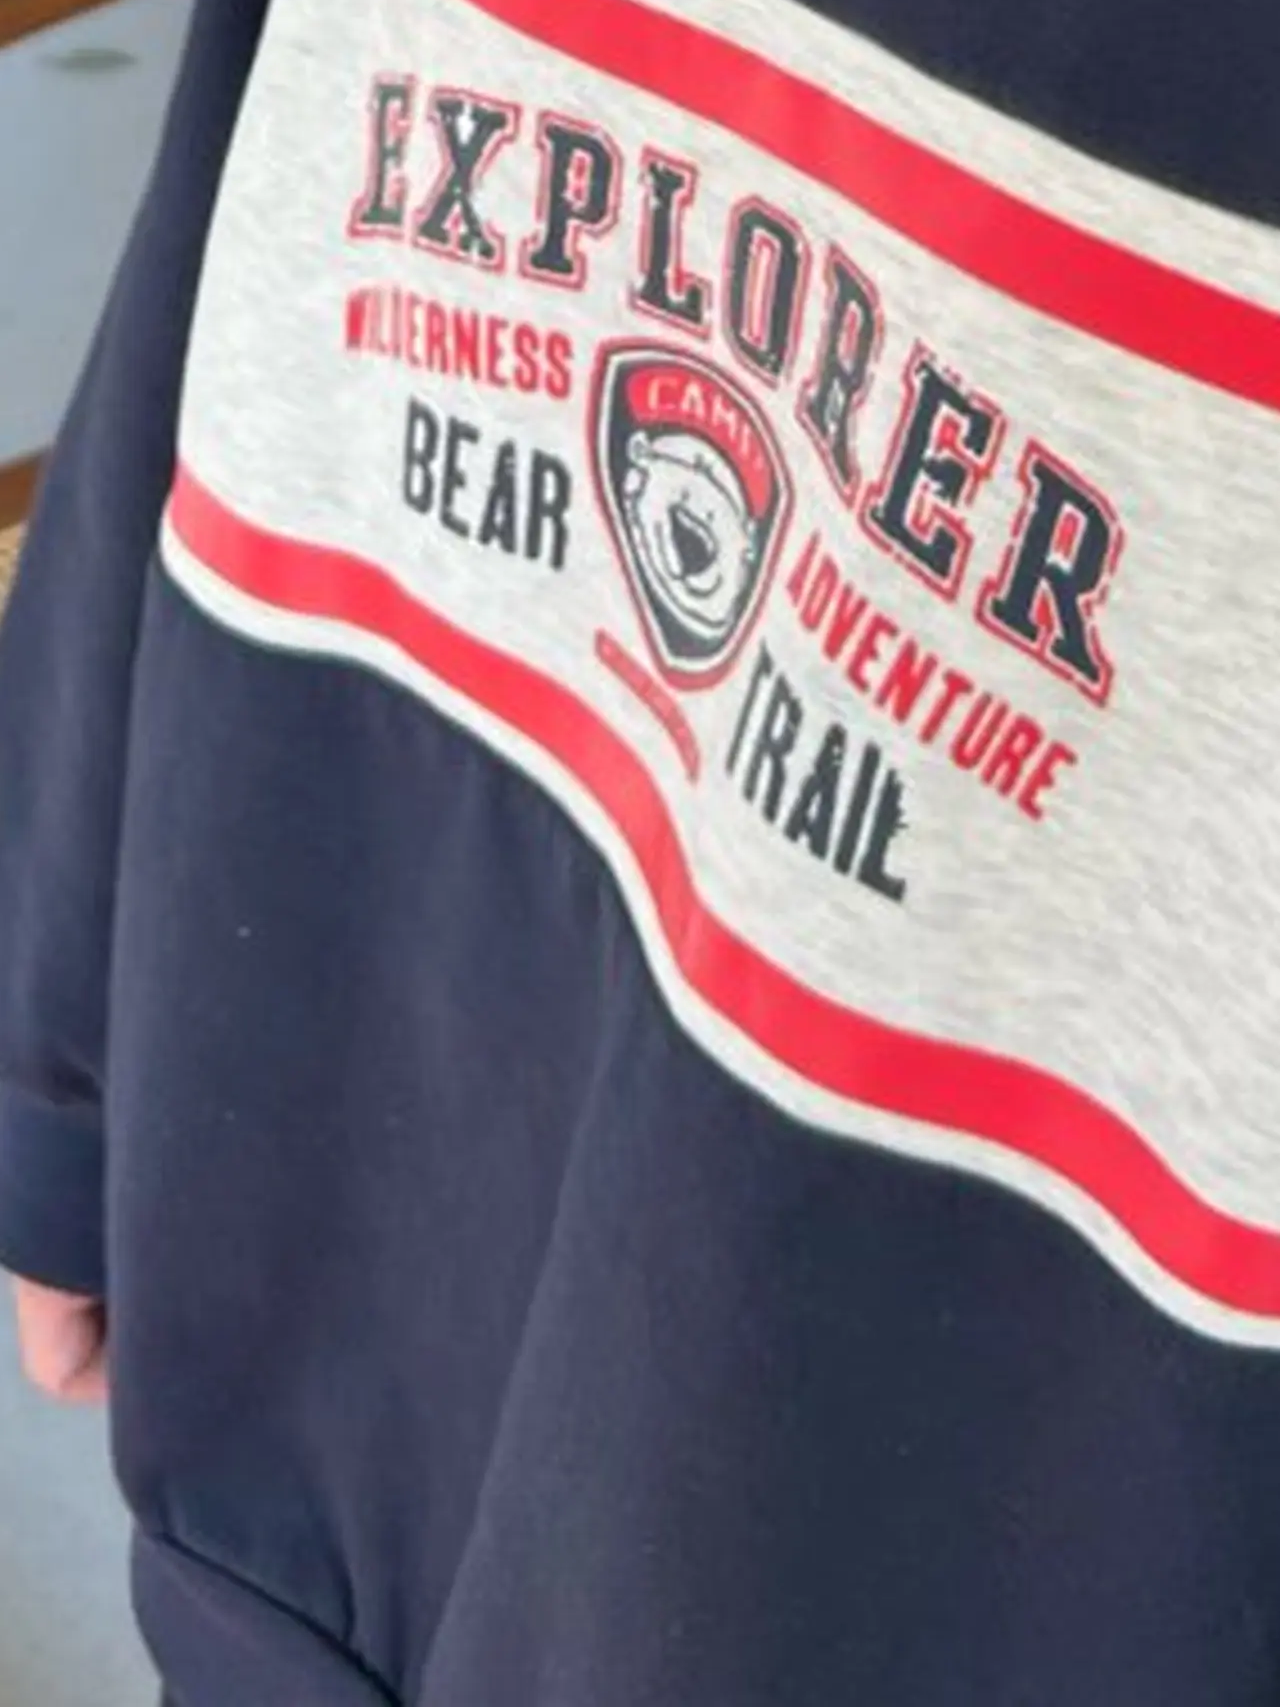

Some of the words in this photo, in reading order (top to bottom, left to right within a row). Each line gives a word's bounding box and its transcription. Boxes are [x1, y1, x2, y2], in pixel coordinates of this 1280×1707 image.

[347, 73, 1126, 707] EXPLORER
[403, 395, 572, 572] BEAR
[726, 638, 907, 903] TRAIL
[786, 532, 1076, 822] ADVENTURE
